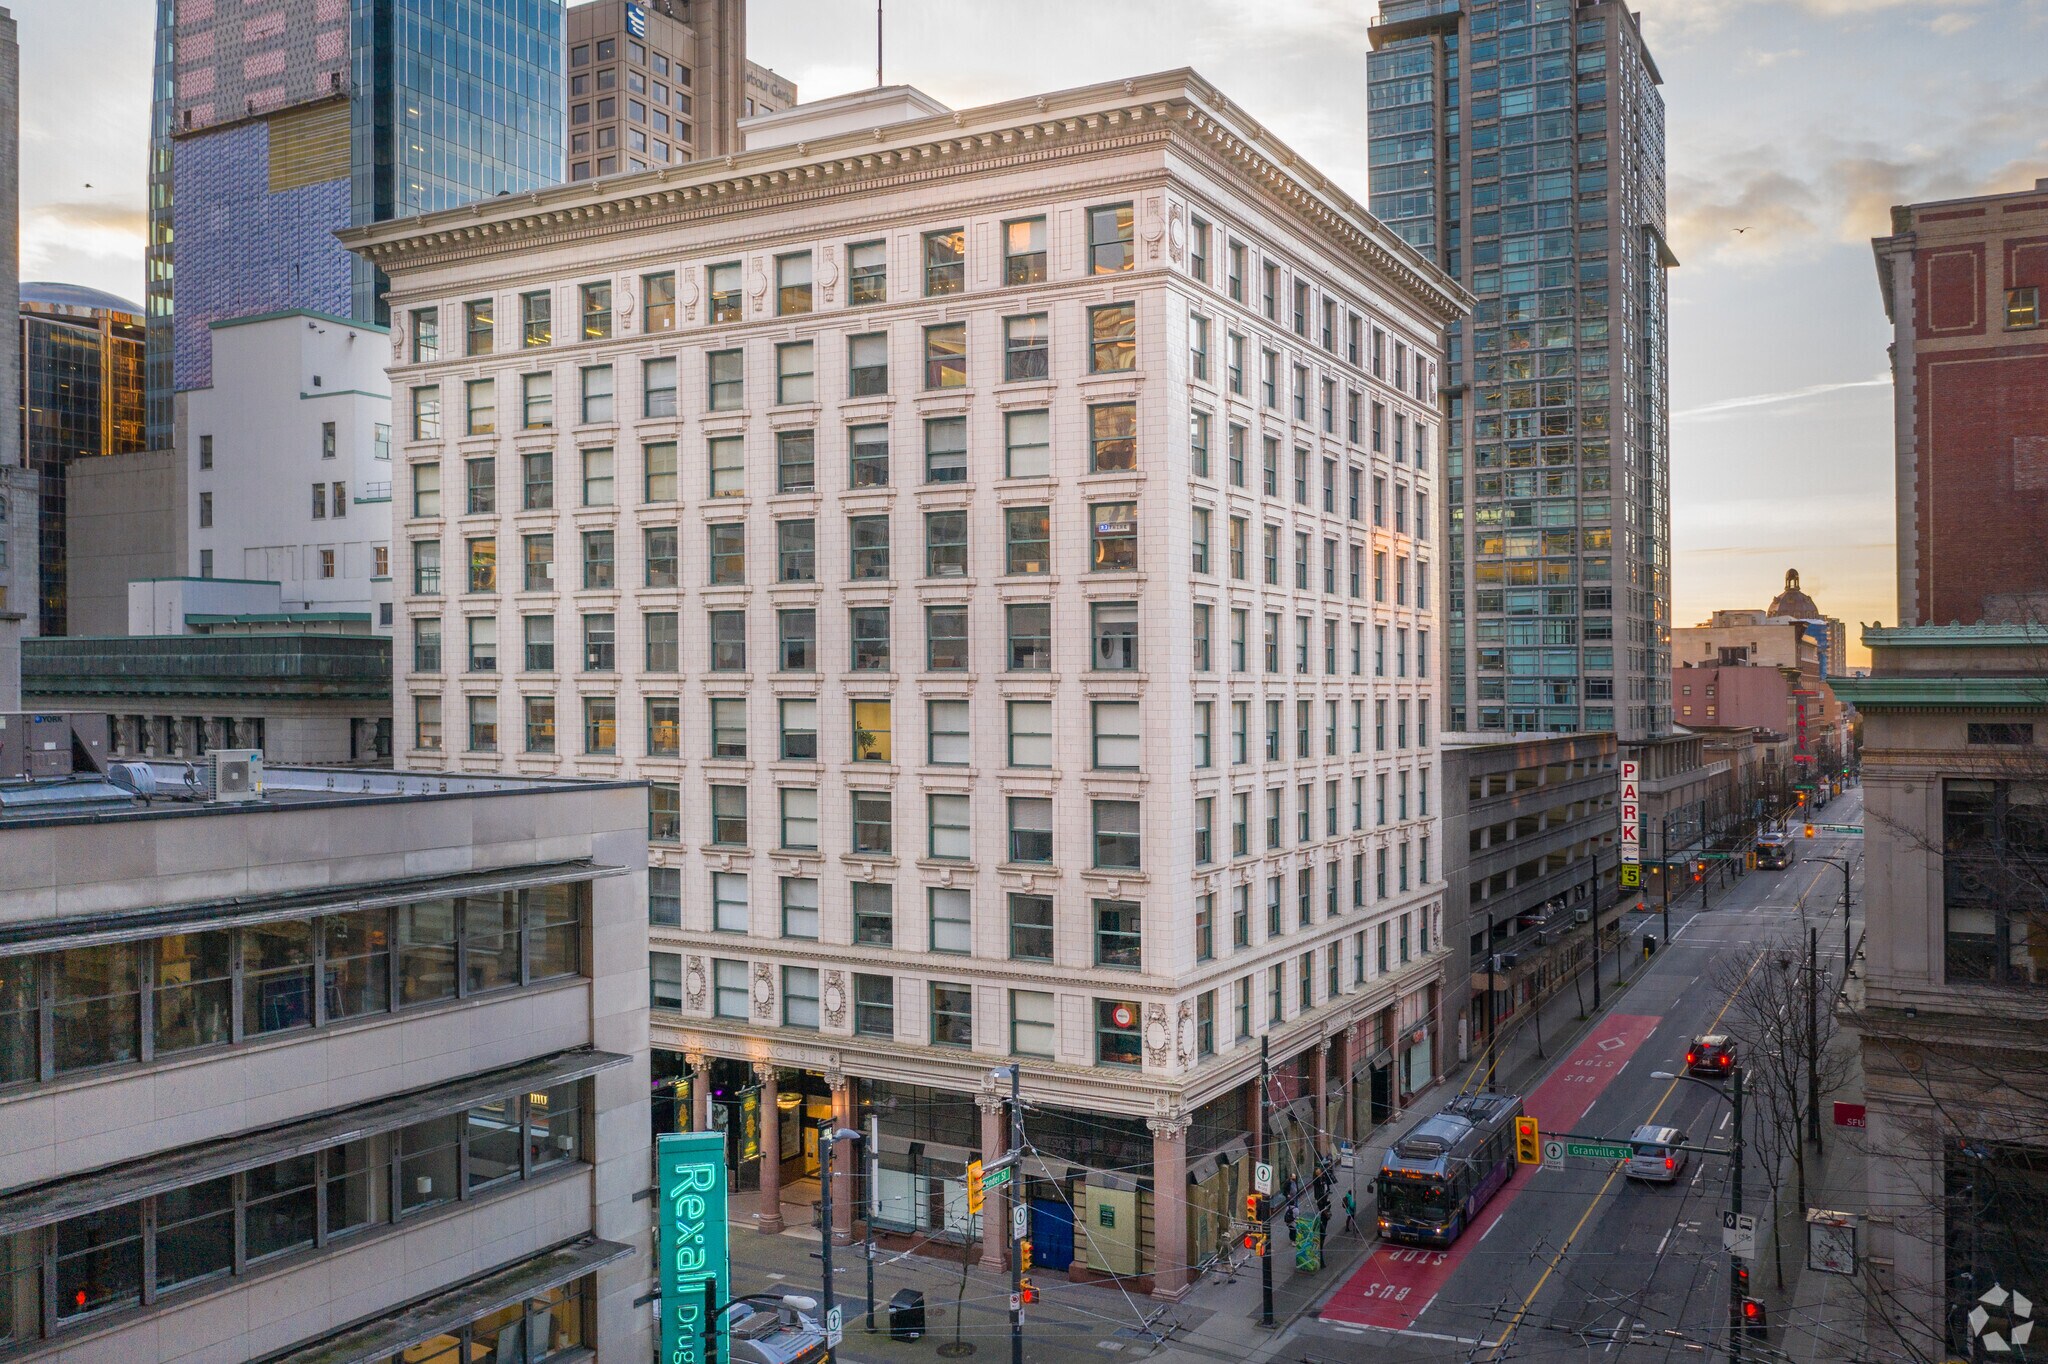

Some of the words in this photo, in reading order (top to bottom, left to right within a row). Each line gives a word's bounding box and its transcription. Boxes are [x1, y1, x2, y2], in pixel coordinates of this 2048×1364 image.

[42, 715, 63, 723] YORK
[1623, 763, 1637, 841] PARK
[674, 1033, 719, 1049] ROGERS
[1575, 1060, 1614, 1068] STOP
[1564, 1074, 1596, 1083] BUS
[1847, 1117, 1865, 1127] SFU
[1572, 1146, 1615, 1157] Granville
[1618, 1149, 1627, 1158] St
[1389, 1249, 1448, 1266] STOP
[1364, 1283, 1412, 1301] BUS
